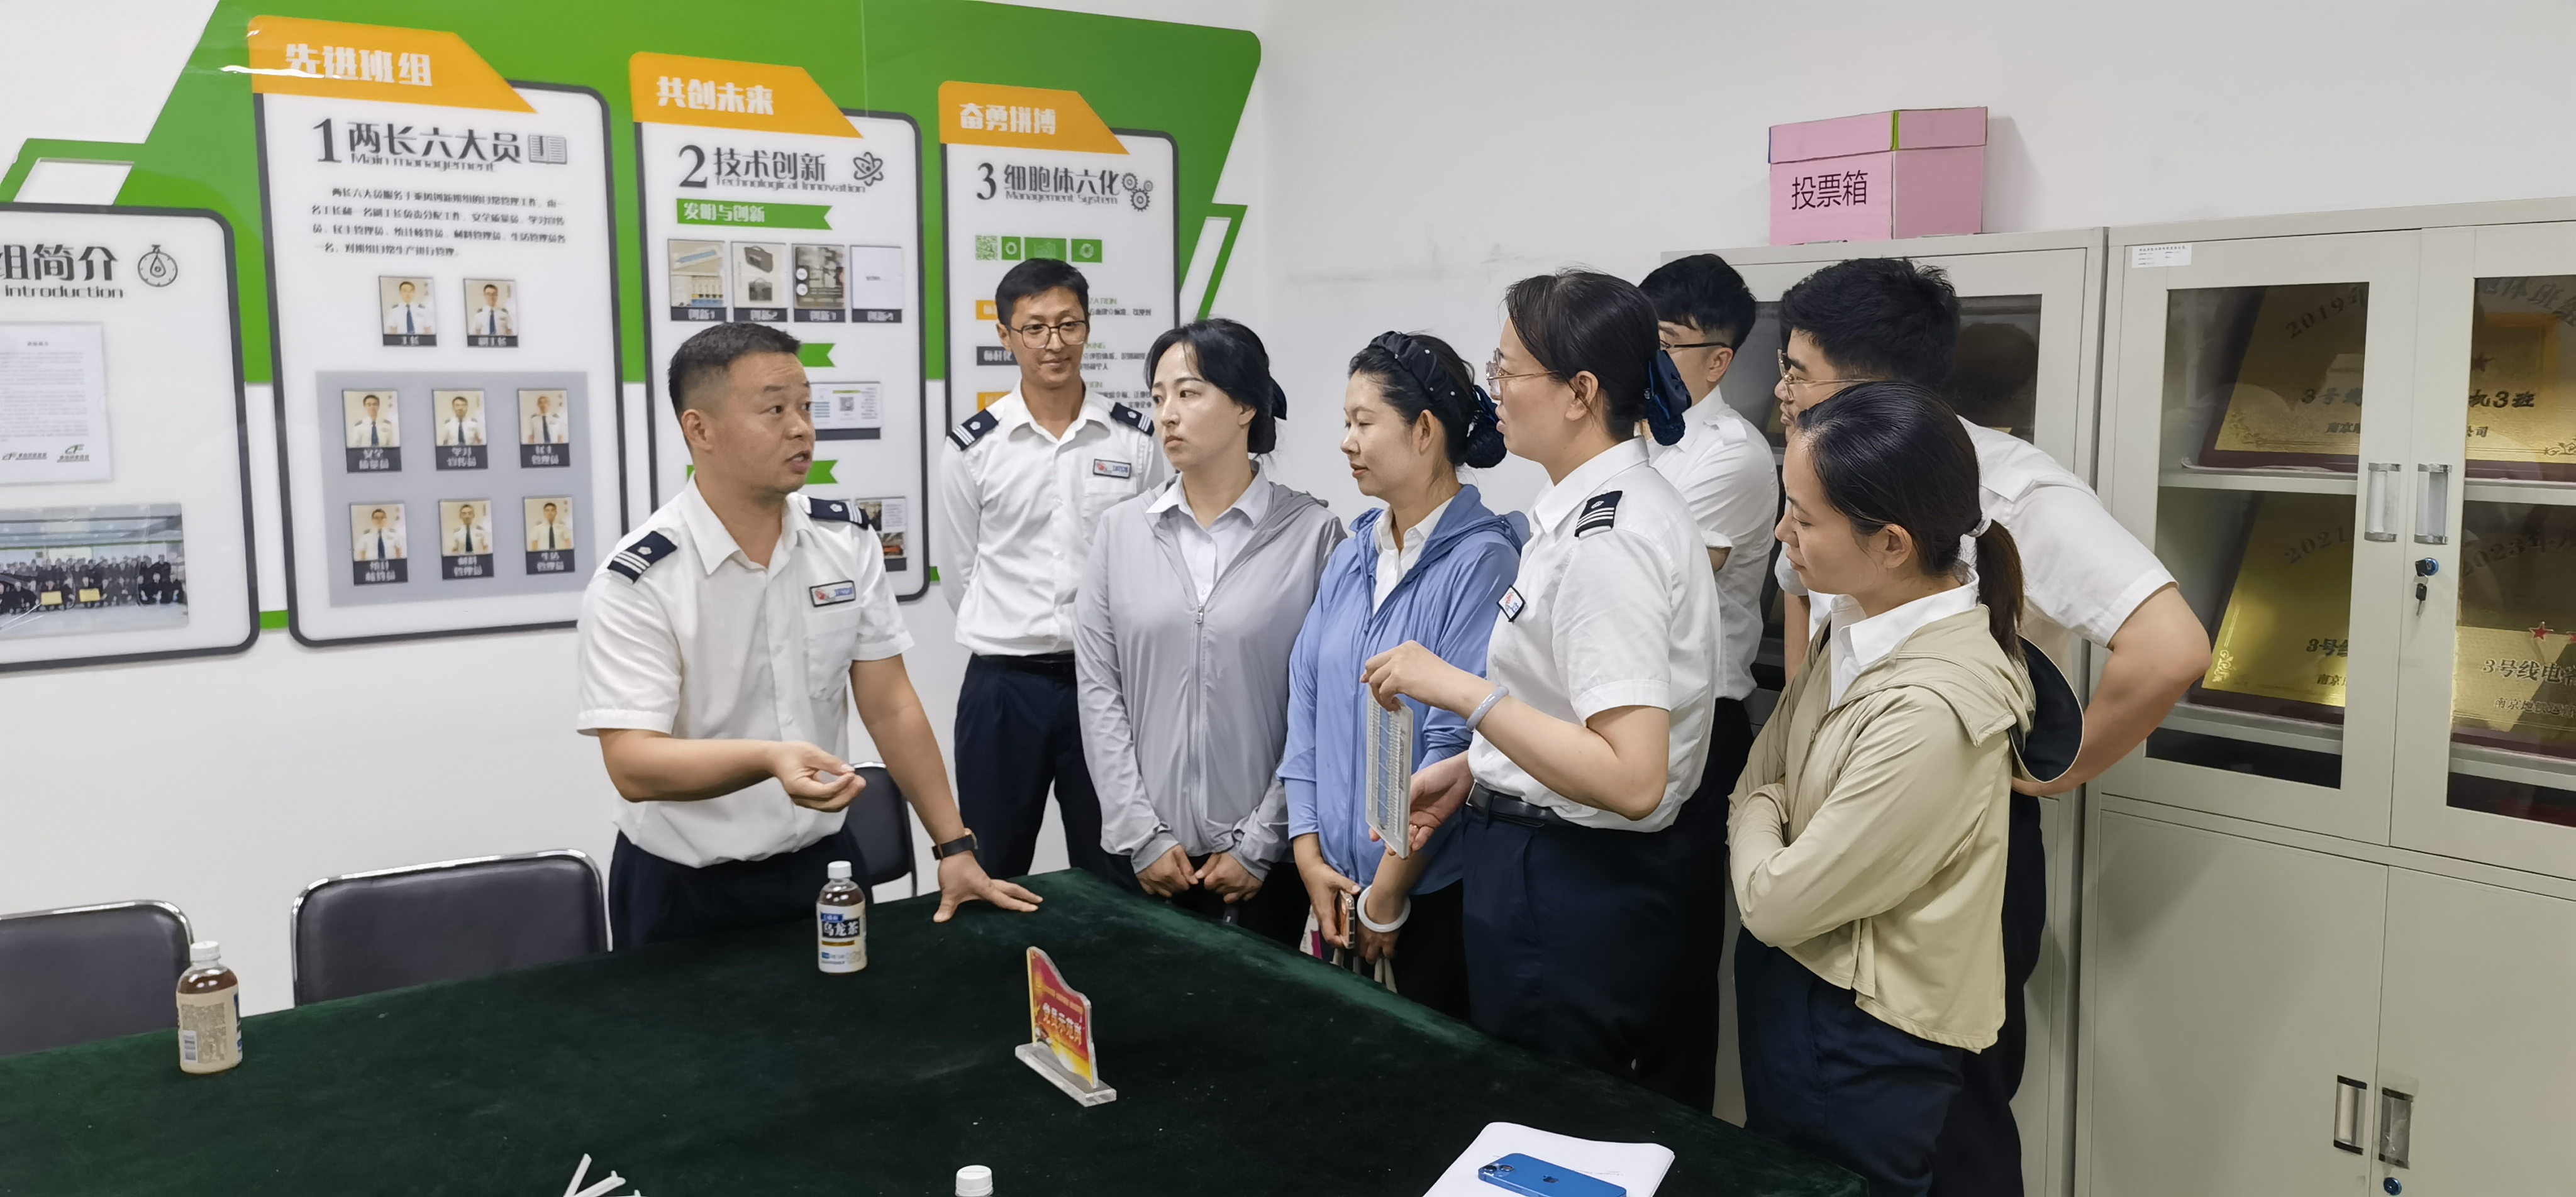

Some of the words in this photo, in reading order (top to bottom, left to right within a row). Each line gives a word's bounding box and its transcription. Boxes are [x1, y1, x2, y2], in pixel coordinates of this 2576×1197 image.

[286, 43, 433, 87] 先进班组
[656, 75, 774, 116] 共创未来
[347, 121, 523, 165] 两长六大员
[351, 153, 389, 166] Main
[713, 146, 826, 182] 技术创新
[1003, 163, 1121, 197] 细胞体六化
[1791, 169, 1869, 211] 投票箱
[683, 202, 766, 223] 发明与创新
